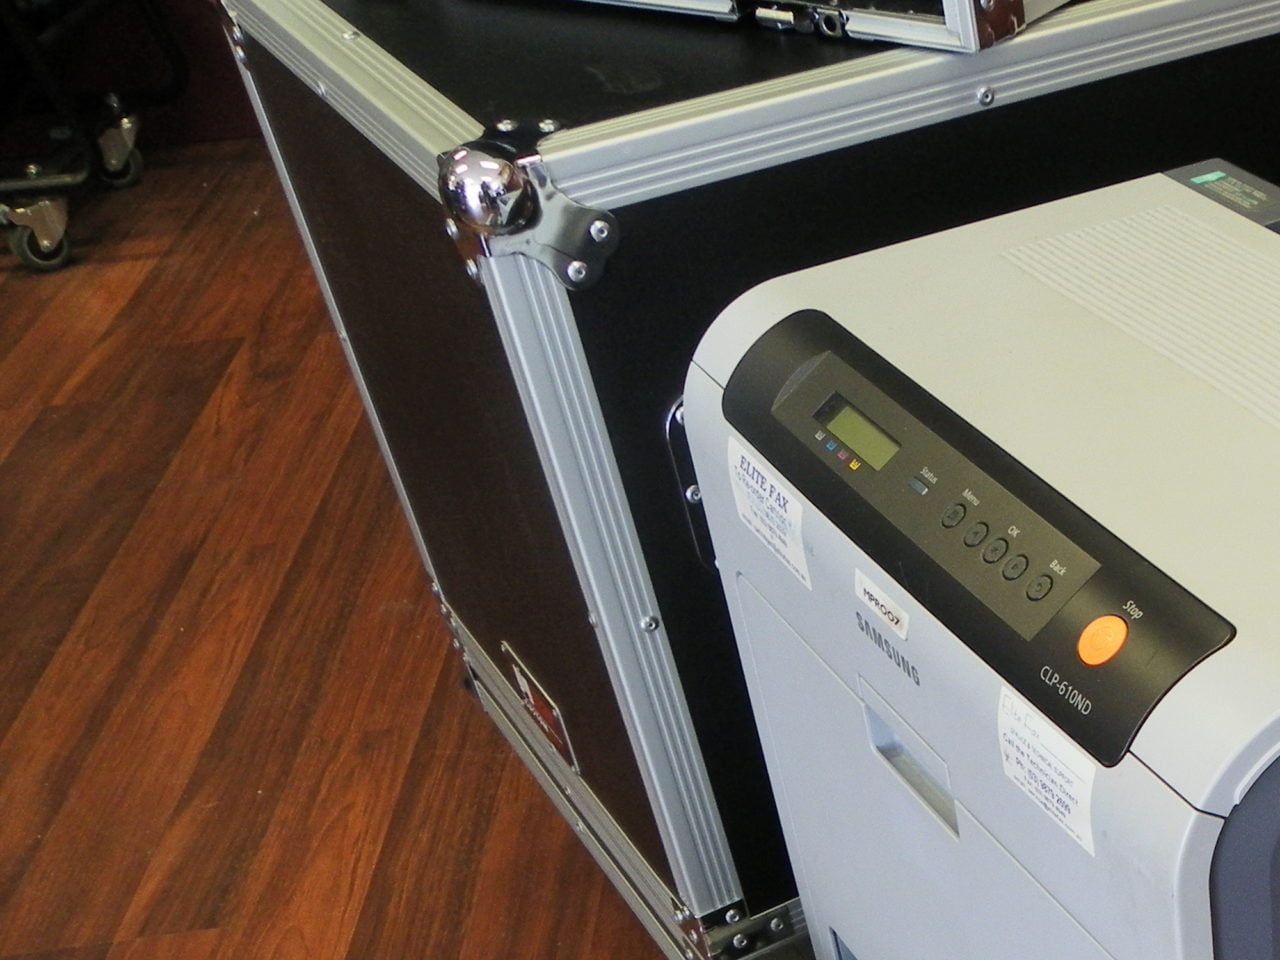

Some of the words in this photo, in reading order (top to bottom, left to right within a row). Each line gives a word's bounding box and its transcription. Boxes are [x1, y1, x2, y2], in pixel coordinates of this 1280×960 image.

[740, 454, 767, 492] ELITE
[769, 483, 789, 514] FAX
[920, 466, 938, 485] Status
[961, 488, 981, 507] Menu
[1007, 525, 1021, 538] OK
[1049, 559, 1067, 577] Back
[863, 587, 901, 626] MPR007
[1122, 600, 1144, 620] Stop
[855, 610, 921, 687] SAMSUNG
[1039, 665, 1093, 716] CLP-610ND
